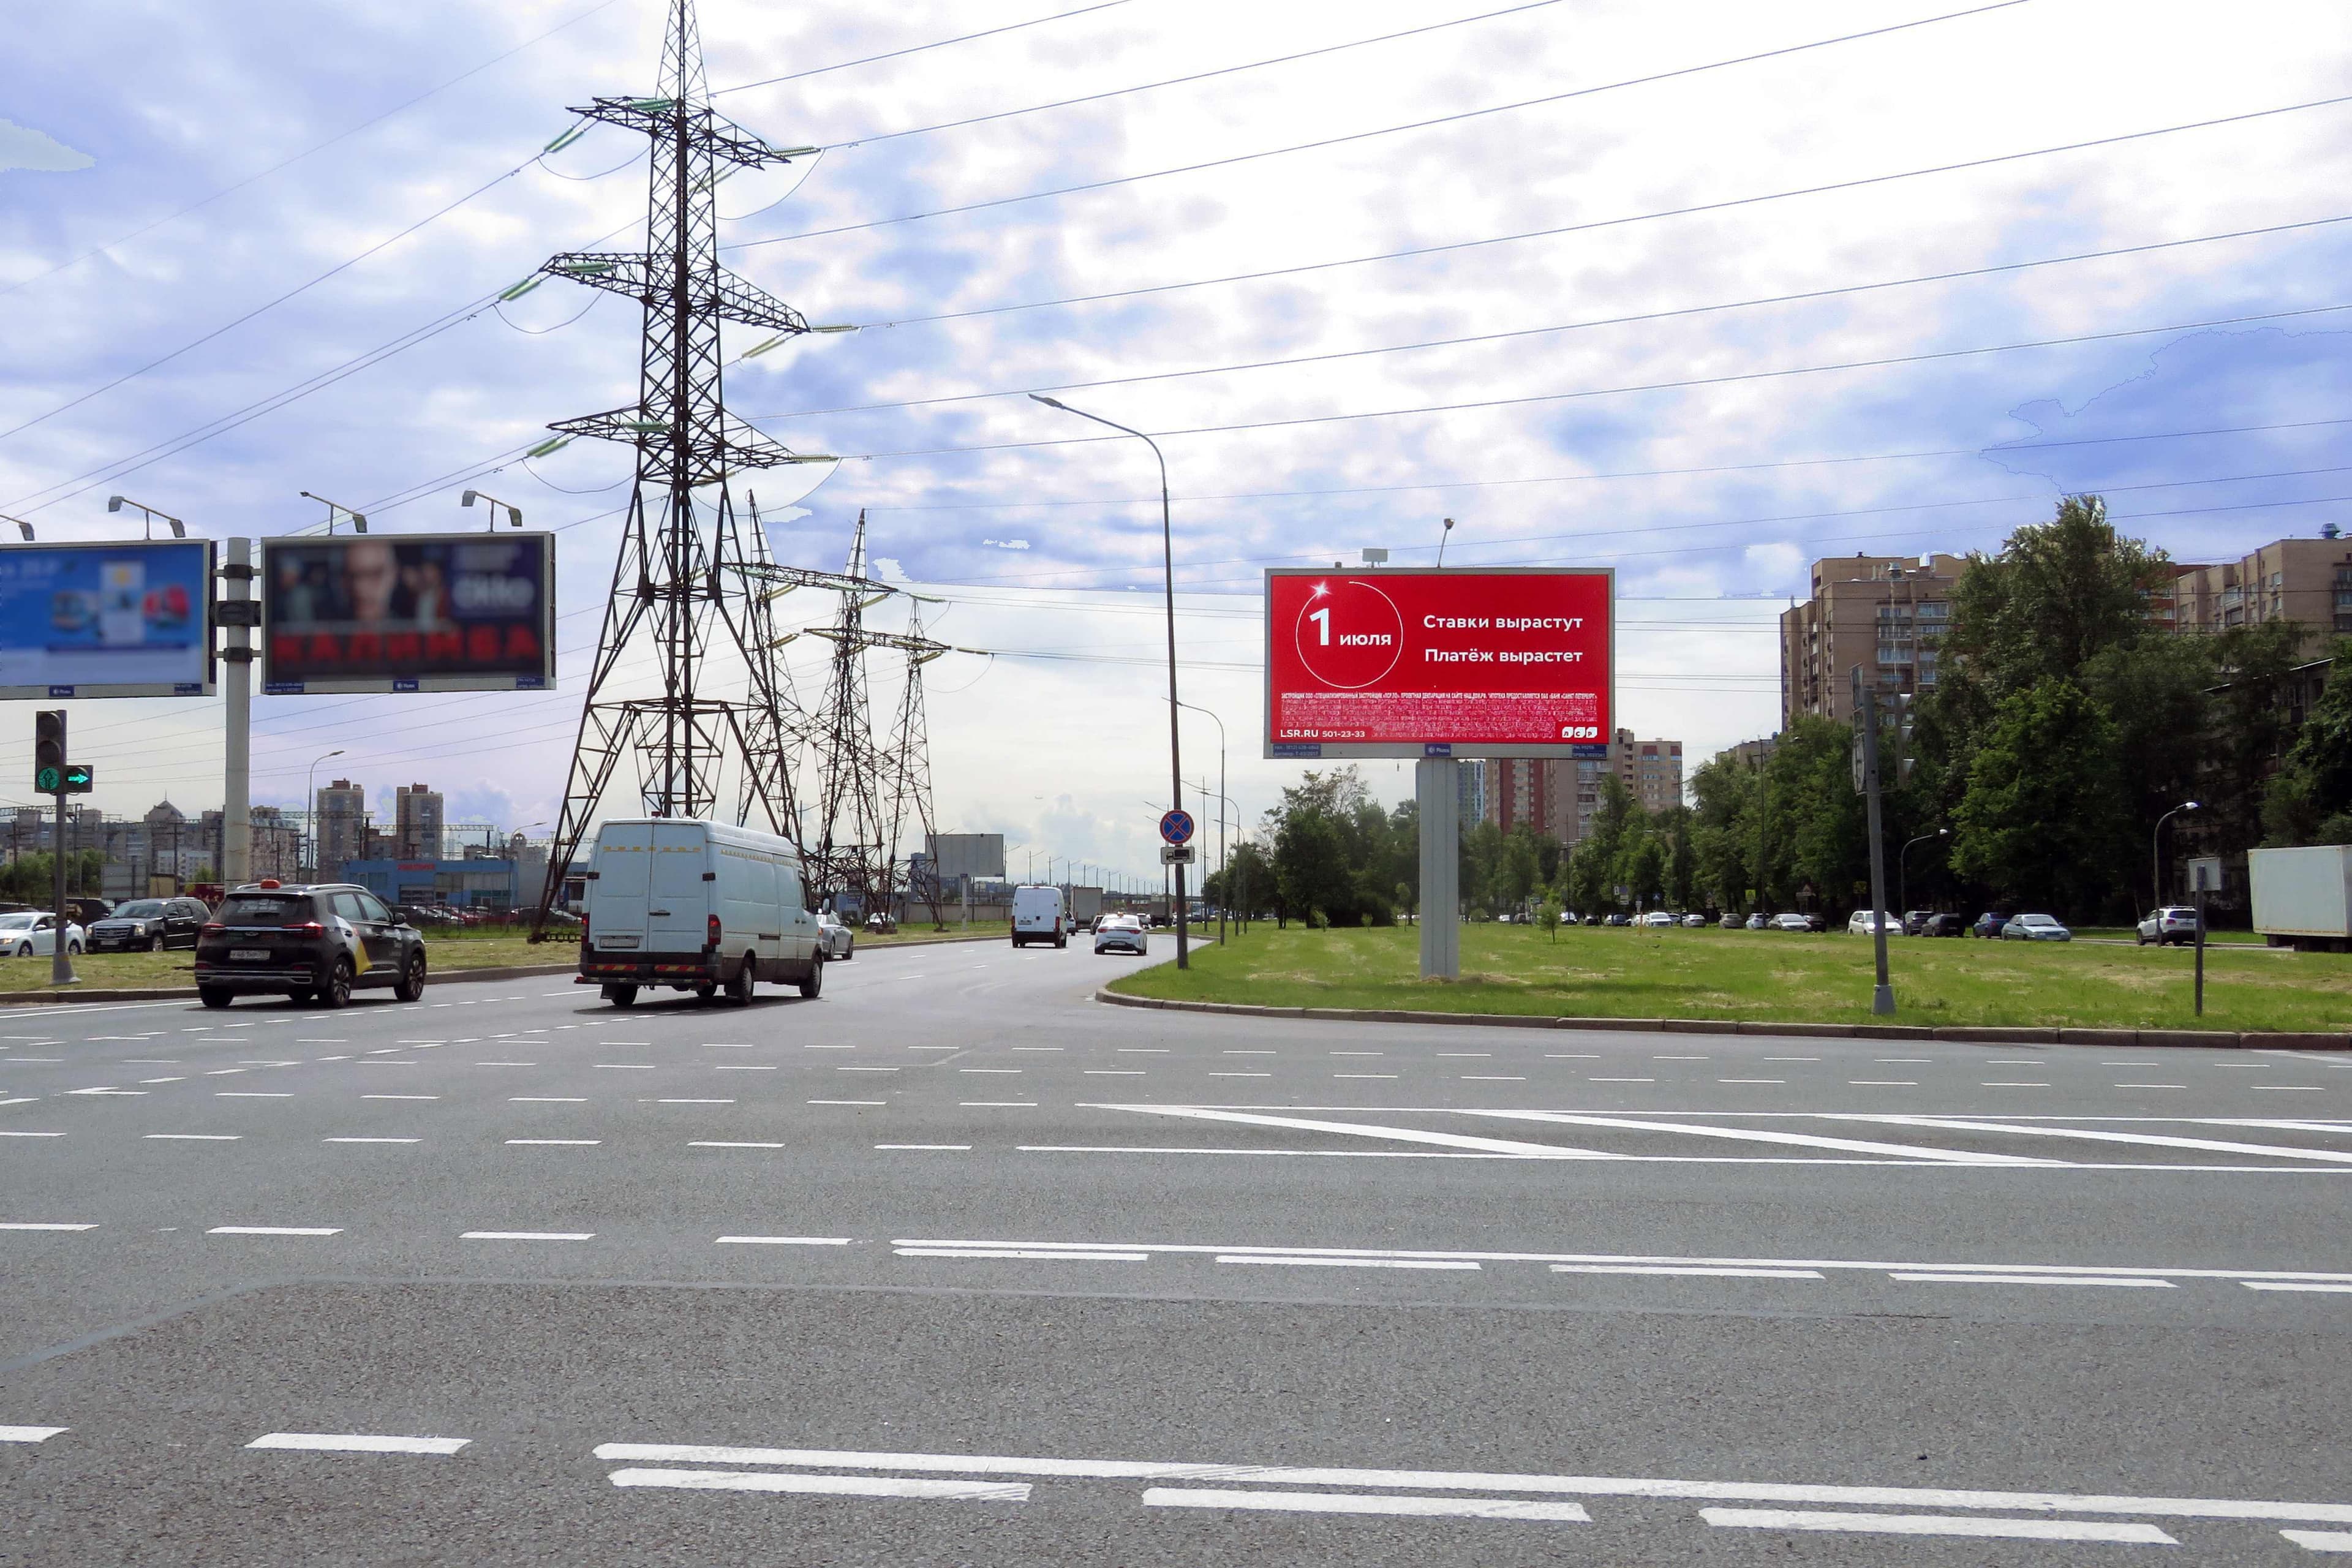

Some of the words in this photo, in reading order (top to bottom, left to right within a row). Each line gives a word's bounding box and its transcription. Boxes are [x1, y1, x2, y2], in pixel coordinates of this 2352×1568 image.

[1309, 608, 1329, 646] 1
[1340, 635, 1392, 646] июля
[1423, 614, 1489, 628] Ставки
[1496, 617, 1583, 631] вырастут
[1425, 648, 1494, 662] Платёж
[1499, 652, 1583, 665] вырастет
[1280, 729, 1319, 737] LSR.RU
